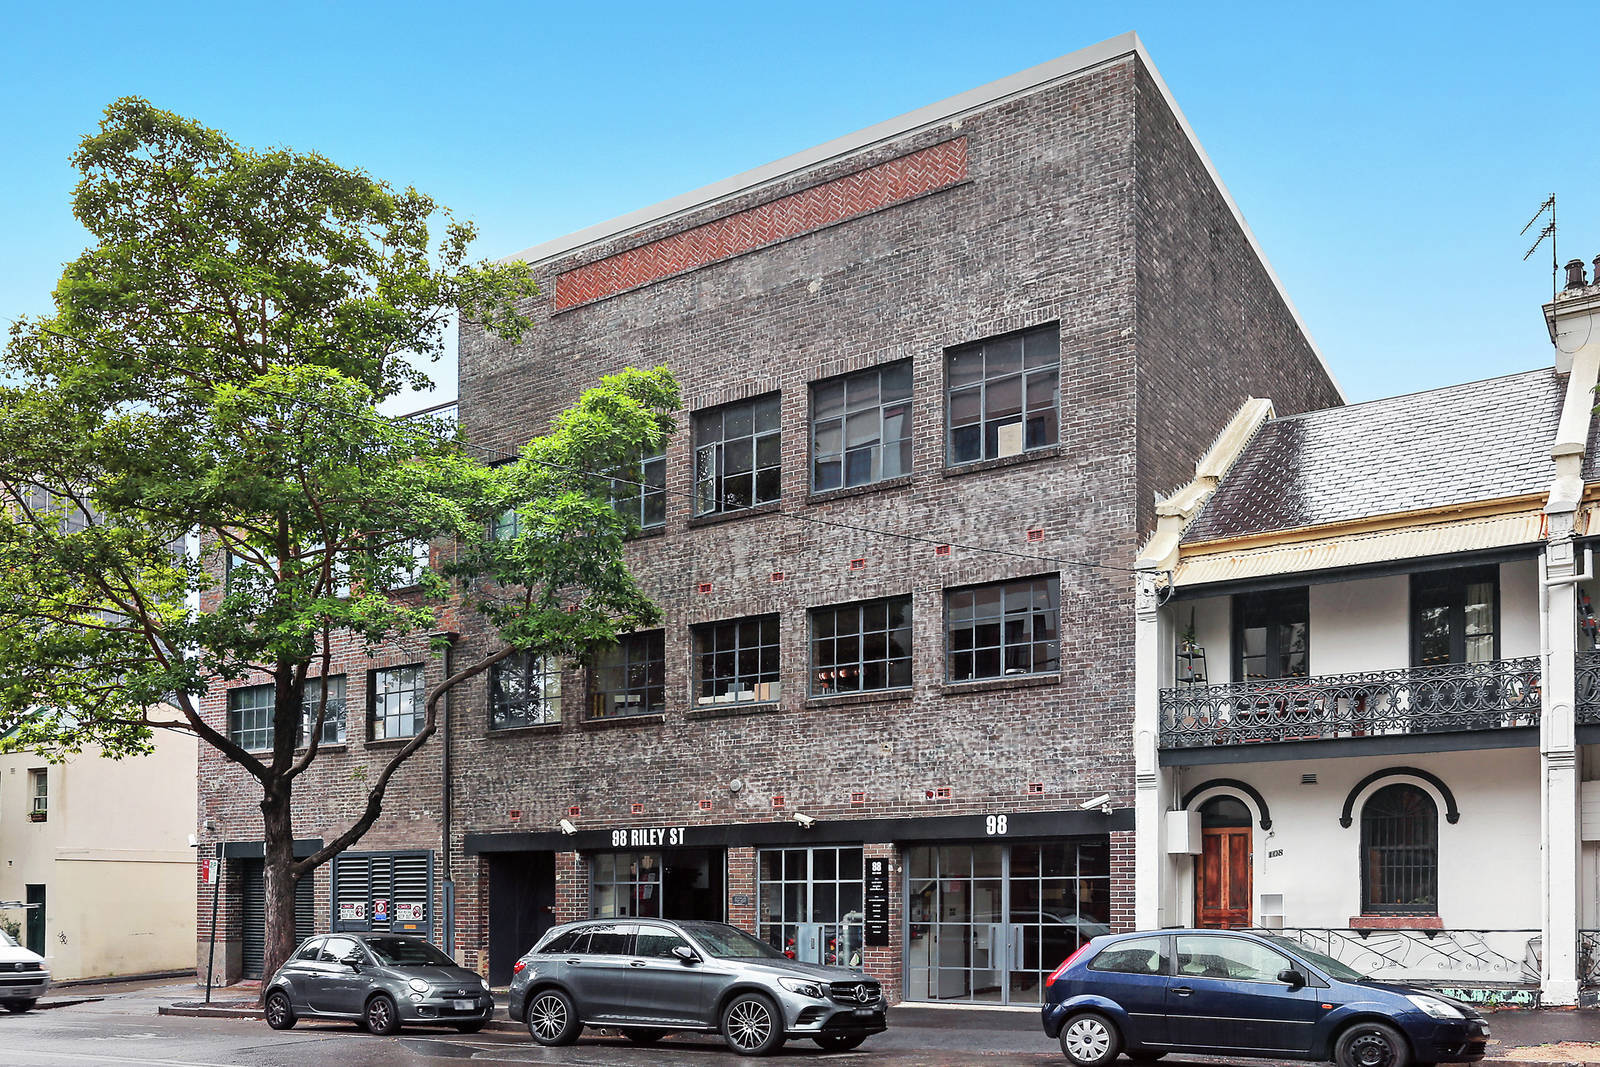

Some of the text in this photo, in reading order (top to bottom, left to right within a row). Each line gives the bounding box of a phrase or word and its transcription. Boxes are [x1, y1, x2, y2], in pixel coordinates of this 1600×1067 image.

[986, 814, 1007, 835] 98
[612, 827, 685, 847] 98 RILEY ST
